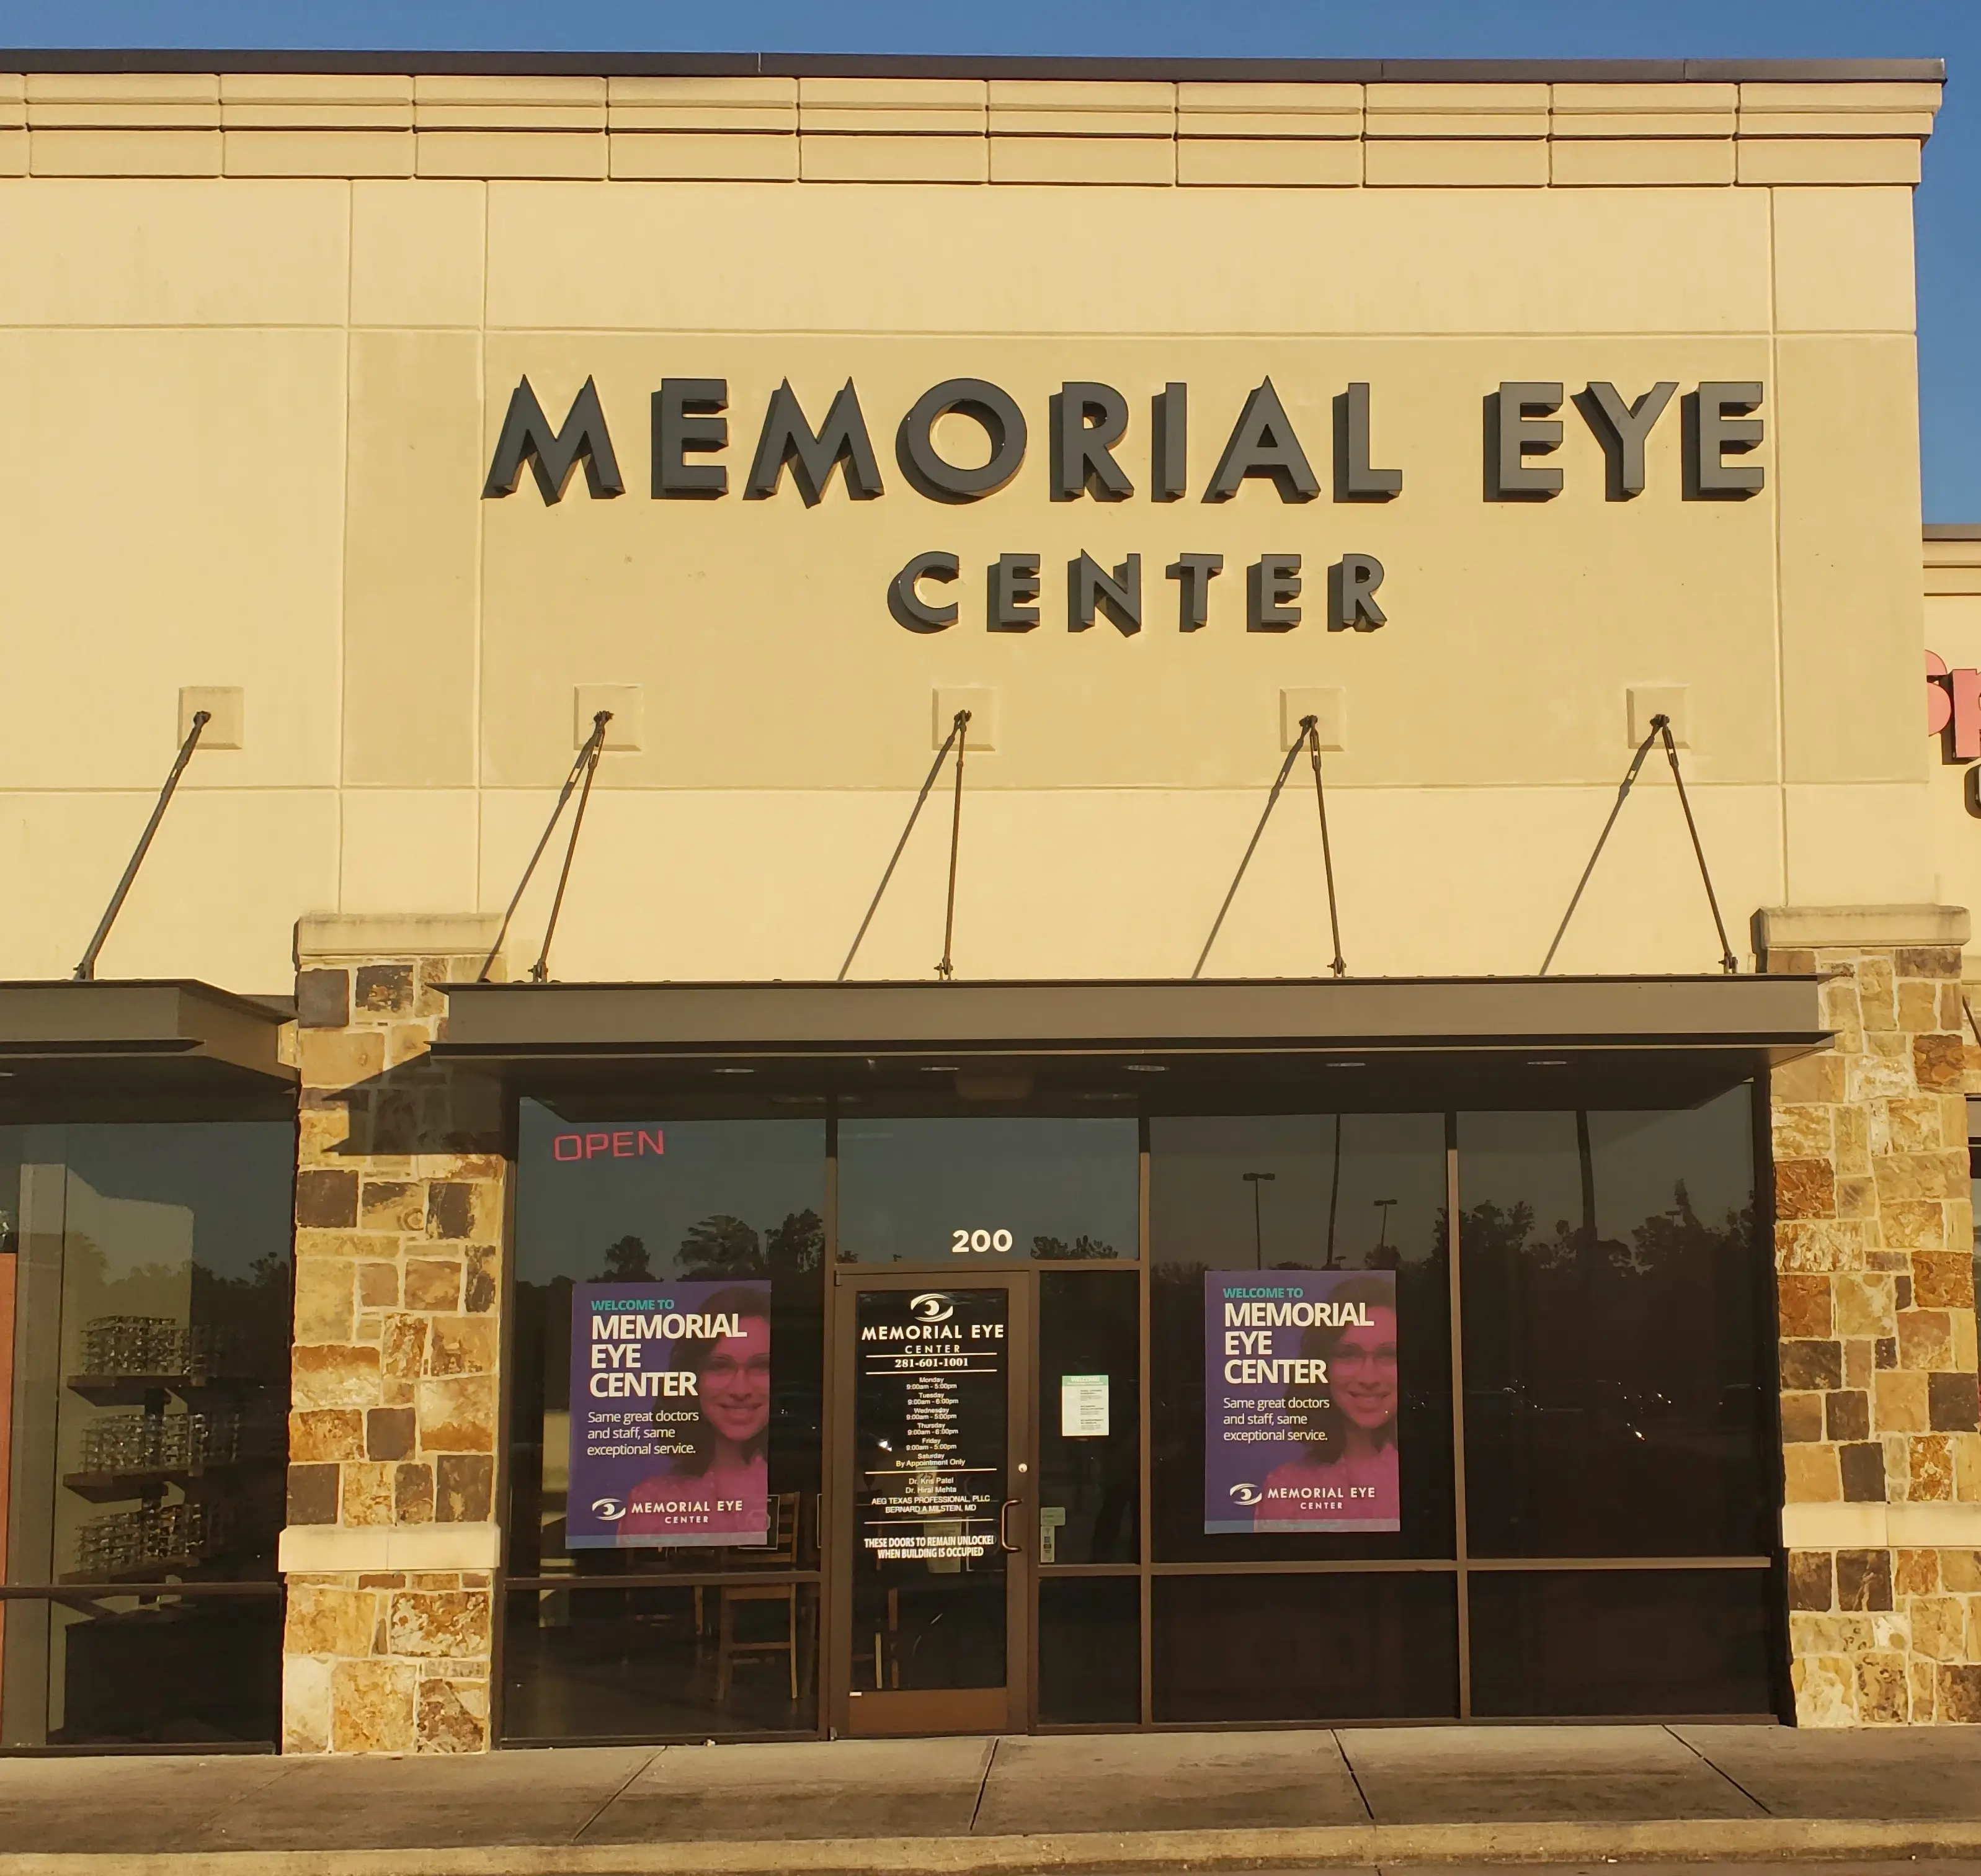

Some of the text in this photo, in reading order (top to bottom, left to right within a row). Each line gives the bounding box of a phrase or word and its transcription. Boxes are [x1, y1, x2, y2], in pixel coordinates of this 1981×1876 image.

[484, 375, 1765, 506] MEMORIAL EYE
[889, 548, 1388, 635] CENTER
[554, 1130, 664, 1161] OPEN
[952, 1229, 1013, 1253] 200
[1223, 1288, 1303, 1298] WELCOME TO
[591, 1299, 674, 1310] WELCOME TO
[1225, 1302, 1374, 1326] MEMORIAL
[592, 1313, 747, 1339] MEMORIAL
[861, 1324, 1004, 1341] MEMORIAL EYE
[905, 1345, 959, 1354] CENTER
[1225, 1331, 1272, 1355] EYE
[591, 1344, 641, 1369] EYE
[895, 1358, 968, 1367] 281-601-1001
[1224, 1359, 1328, 1383] CENTER
[590, 1372, 698, 1397] CENTER
[1223, 1397, 1330, 1411] Same great doctors
[588, 1410, 698, 1425] Same great doctors
[1224, 1414, 1307, 1426] and staff, same
[587, 1427, 675, 1440] and staff, same
[1224, 1429, 1327, 1444] exceptional service.
[587, 1443, 695, 1458] exceptional service.
[906, 1459, 948, 1467] Appointment
[914, 1496, 970, 1504] PROFESSIONAL,
[1268, 1488, 1375, 1498] MEMORIAL EYE
[631, 1500, 742, 1513] MEMORIAL EYE
[665, 1516, 708, 1524] CENTER
[864, 1538, 887, 1548] THESE
[889, 1537, 914, 1547] DOORS
[916, 1537, 925, 1547] TO
[927, 1537, 955, 1546] REMAIN
[878, 1547, 984, 1558] WHEN BUILDING IS OCCUPIED
